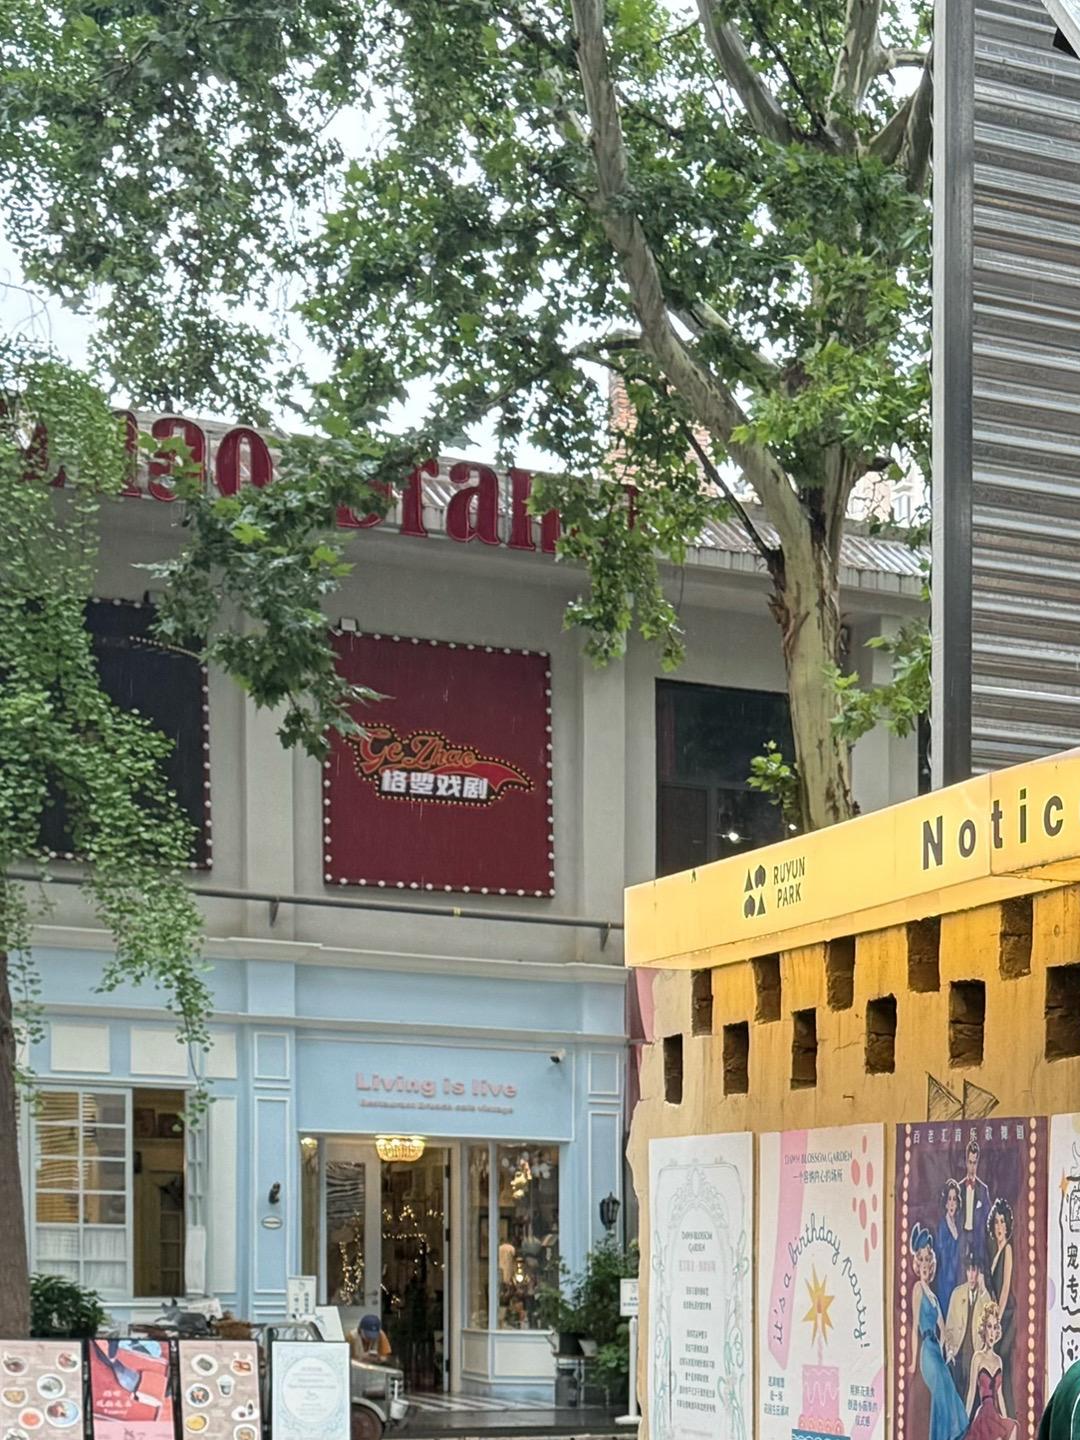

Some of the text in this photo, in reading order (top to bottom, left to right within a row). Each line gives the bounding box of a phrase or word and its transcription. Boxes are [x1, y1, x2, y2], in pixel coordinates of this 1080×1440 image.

[350, 728, 477, 774] Ge Zhao
[773, 856, 805, 886] RUYUN
[777, 882, 801, 909] PARK
[356, 1072, 517, 1098] Living is live
[788, 1212, 840, 1267] birthday
